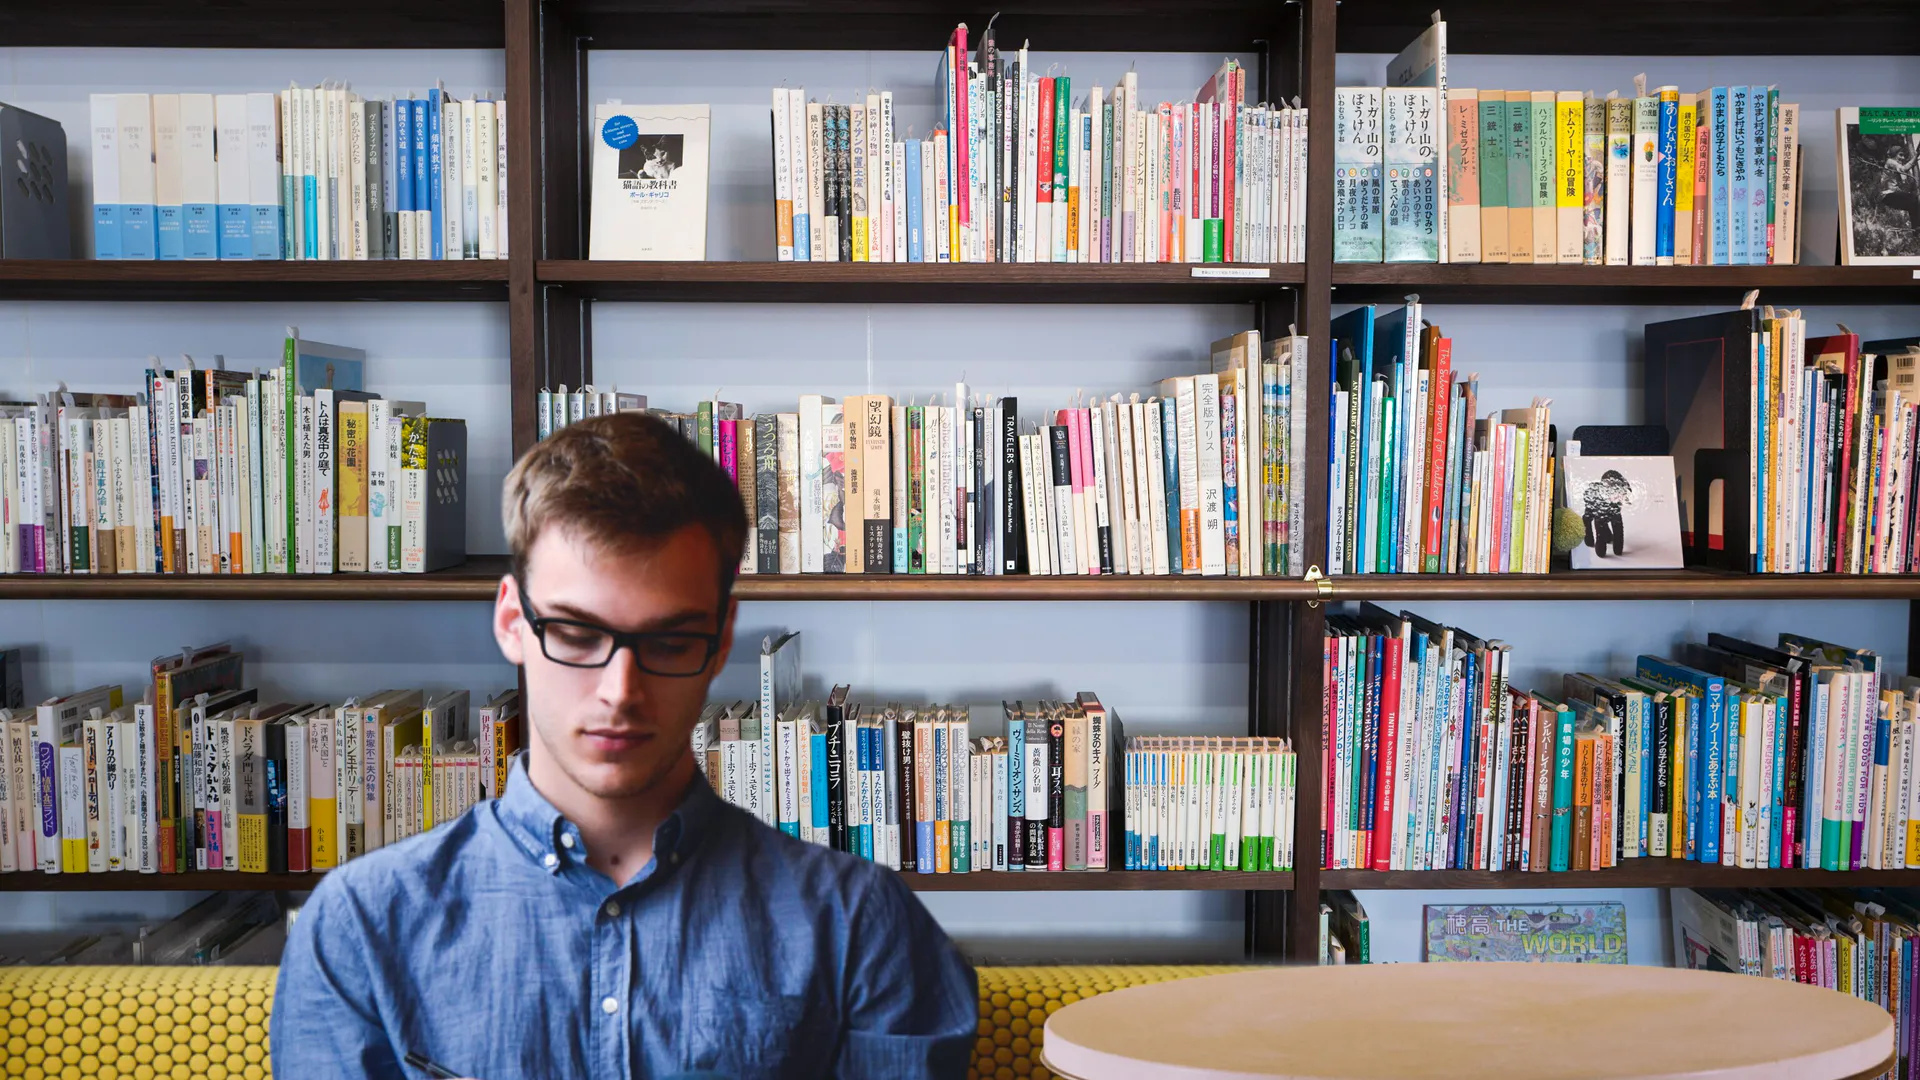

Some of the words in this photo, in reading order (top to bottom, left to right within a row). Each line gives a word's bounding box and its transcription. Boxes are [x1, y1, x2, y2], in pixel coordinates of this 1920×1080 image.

[398, 106, 407, 150] 地図のない道
[415, 106, 424, 150] 地図のない道
[1352, 94, 1365, 145] ぼうけん
[1366, 94, 1379, 157] トガリ山の
[1388, 95, 1396, 122] いわむら
[1404, 95, 1417, 145] ぼうけん
[1419, 95, 1432, 158] トガリ山の
[1486, 106, 1497, 146] 三銃士
[1512, 106, 1523, 147] 三銃士
[431, 134, 441, 174] 須賀敦子
[1566, 107, 1576, 197] トム・ソーヤーの冒険
[1664, 101, 1678, 206] あしながおじさん
[1682, 112, 1691, 163] 鏡の国のアリス
[1714, 94, 1726, 177] やかまし村の子どもたち
[1734, 92, 1745, 182] やかまし村はいつもにぎやか
[1754, 94, 1765, 178] やかまし村の春・夏・秋・冬
[623, 180, 678, 190] 猫語の教科書
[629, 191, 670, 199] ポール・ギャリコ
[1336, 179, 1345, 231] 空飛ぶウロロ
[1348, 179, 1357, 230] 月夜のキノコ
[1360, 179, 1369, 230] ゆうだちの森
[1371, 179, 1380, 215] 風の草原
[1440, 348, 1450, 365] The
[180, 377, 190, 419] 田園の食卓
[1438, 368, 1449, 399] Silver
[302, 406, 311, 459] 木を植えた男
[1201, 382, 1215, 452] 完全版アリス
[1350, 393, 1358, 428] ALPHABET
[1436, 404, 1447, 435] Spoon
[317, 400, 329, 477] トムは真夜中の庭で
[346, 419, 357, 468] 秘密の花園
[408, 432, 420, 467] かたち
[762, 418, 777, 472] うつろ舟
[1006, 415, 1015, 464] TRAVELERS
[1348, 437, 1356, 467] ANIMALS
[1435, 437, 1445, 453] for
[1433, 458, 1444, 501] Children
[1206, 488, 1218, 530] 沢渡朔
[311, 723, 319, 753] その時代
[482, 715, 491, 765] 伊丹十三の本
[901, 731, 911, 765] 壁抜け男
[1071, 726, 1081, 753] 緑の家
[1092, 716, 1102, 765] 蜘蛛女のキス
[1387, 712, 1395, 737] TINTIN
[1510, 716, 1521, 765] ペニーさん
[1518, 716, 1529, 764] ペニーさん
[1627, 699, 1639, 774] あの年の春は早くきた
[1658, 706, 1669, 788] グリーン・ノウの子どもたち
[1691, 703, 1699, 750] のんきなりゅう
[1707, 693, 1723, 800] マザーグースとあそぶ本
[1817, 732, 1826, 760] spaces
[106, 726, 117, 791] アメリカの鱒釣り
[346, 718, 358, 803] シャボン玉ホリデー
[365, 730, 376, 802] 赤塚不二夫の特集
[828, 720, 842, 790] プチ・ニコラ
[1012, 729, 1022, 814] ヴァーミリオン・サンズ
[1032, 747, 1042, 793] 薔薇の名前
[1403, 759, 1411, 782] STORY
[1479, 736, 1488, 786] オリビア
[1538, 720, 1552, 809] シルバー・レイクの岸辺で
[1560, 723, 1572, 780] 農場の少年
[1580, 743, 1589, 804] ドリトル先生のサーカス
[1861, 733, 1870, 768] GOODS
[1903, 739, 1911, 776] 絵本を抱えて
[748, 742, 758, 809] チェーホフ・ユモレスカ
[783, 732, 793, 823] ポケットから出てきたミステリー
[861, 773, 869, 823] うたかたの日々
[874, 773, 883, 823] うたかたの日々
[1859, 769, 1867, 790] FOR
[1857, 792, 1866, 815] KIDS
[1029, 823, 1037, 857] の問題小説
[1037, 823, 1045, 857] 今世紀最大
[1447, 913, 1490, 935] 穂高
[1496, 919, 1529, 932] THE
[1521, 933, 1622, 955] WORLD
